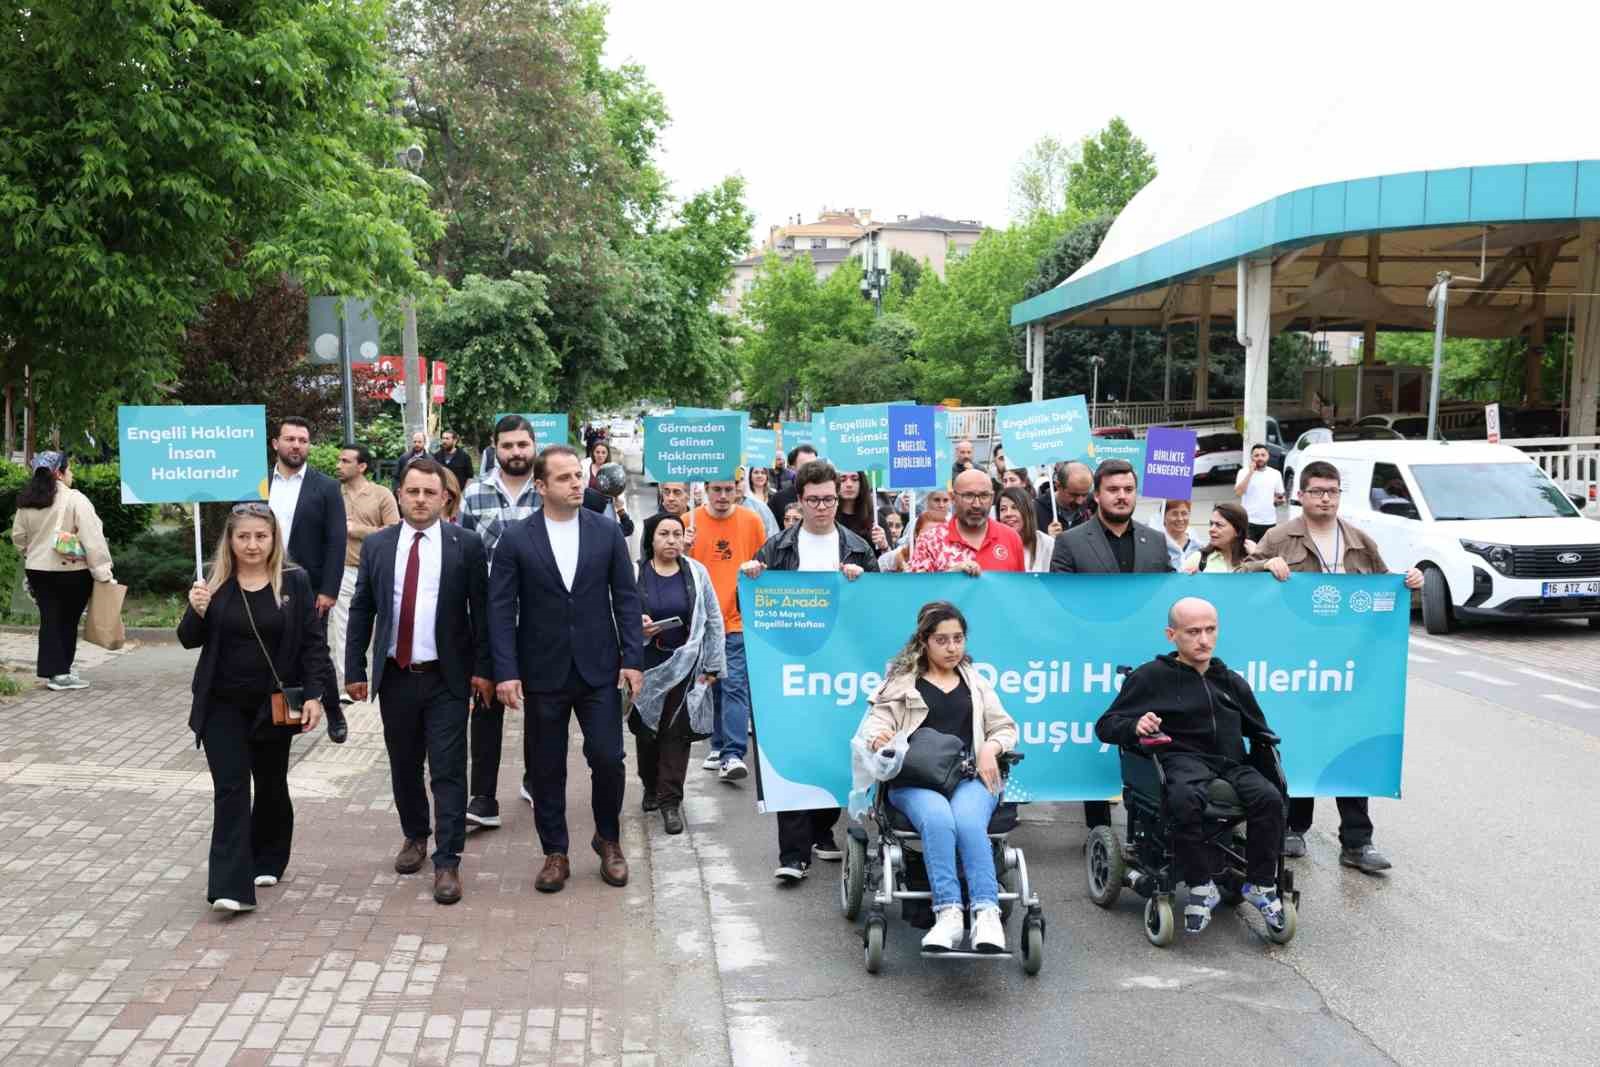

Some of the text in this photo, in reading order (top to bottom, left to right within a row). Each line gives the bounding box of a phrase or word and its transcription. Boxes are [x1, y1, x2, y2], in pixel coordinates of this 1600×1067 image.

[658, 422, 726, 433] Görmezden
[829, 418, 878, 432] Engellilik
[127, 426, 255, 443] Engelli Hakları
[840, 432, 888, 444] Erişimsiz
[669, 436, 714, 447] Gelinen
[168, 443, 216, 460] İnsan
[1094, 445, 1140, 453] örmezden
[1153, 448, 1185, 463] BİRLİKTE
[657, 451, 725, 462] Haklarımızı
[151, 466, 240, 480] Haklarıdır
[667, 463, 719, 476] İstiyoruz
[1146, 463, 1191, 477] DENGEDEYİZ
[781, 595, 830, 608] Arada
[779, 610, 806, 619] Mayıs
[794, 620, 825, 629] Haftası
